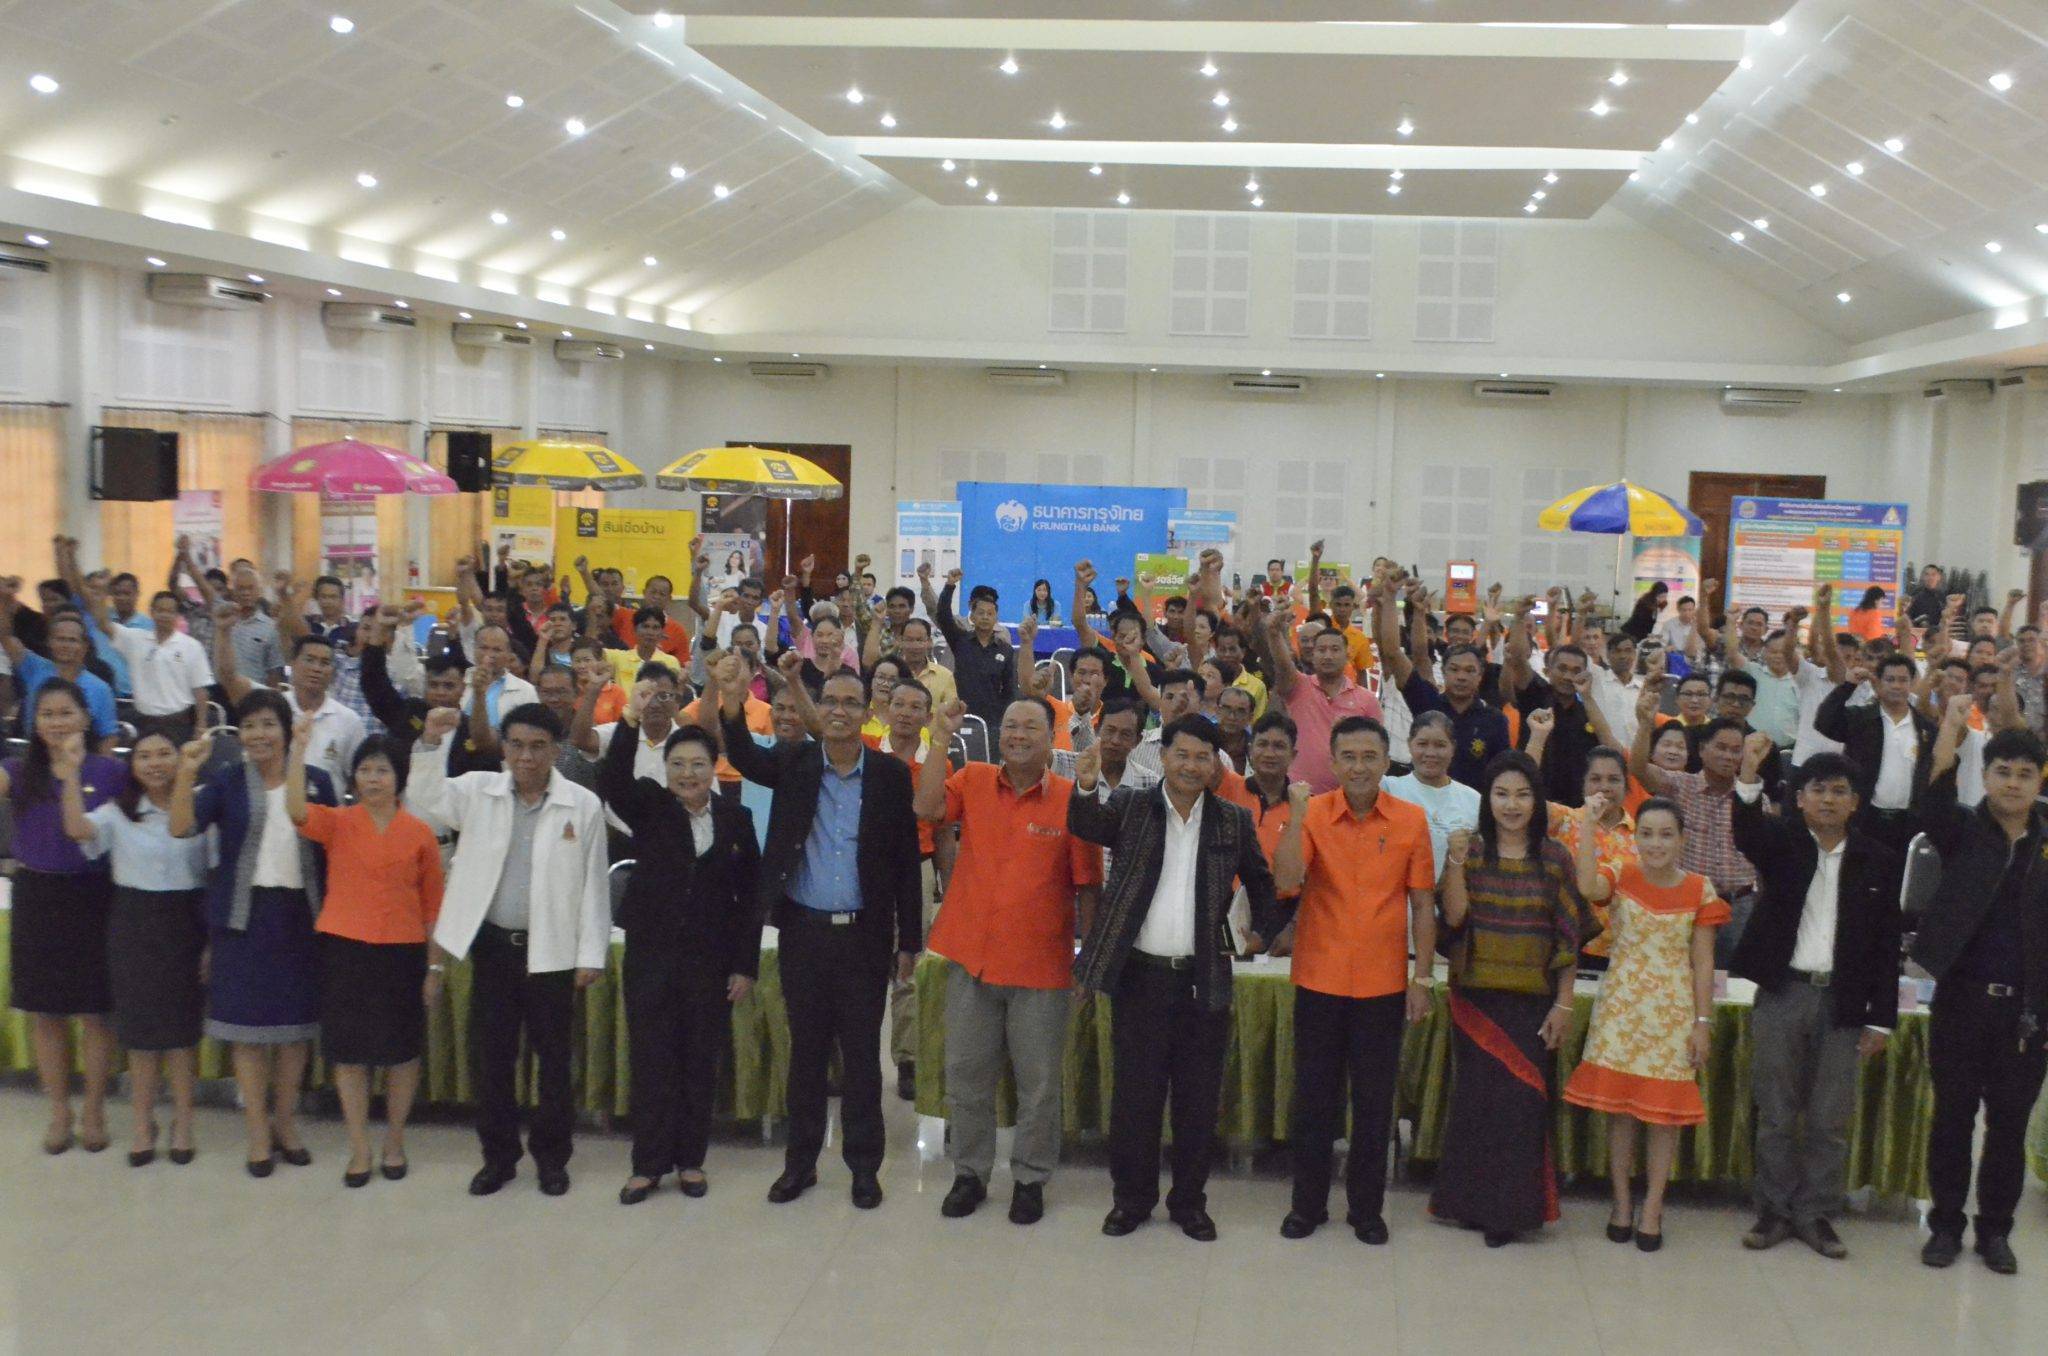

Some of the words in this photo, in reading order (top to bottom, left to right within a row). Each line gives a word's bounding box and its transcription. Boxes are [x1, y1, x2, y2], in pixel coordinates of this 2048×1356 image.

[1032, 504, 1144, 524] ธนาคารกรุงไทย
[1032, 521, 1091, 532] KRUNGTHAI
[1093, 523, 1121, 533] BANK
